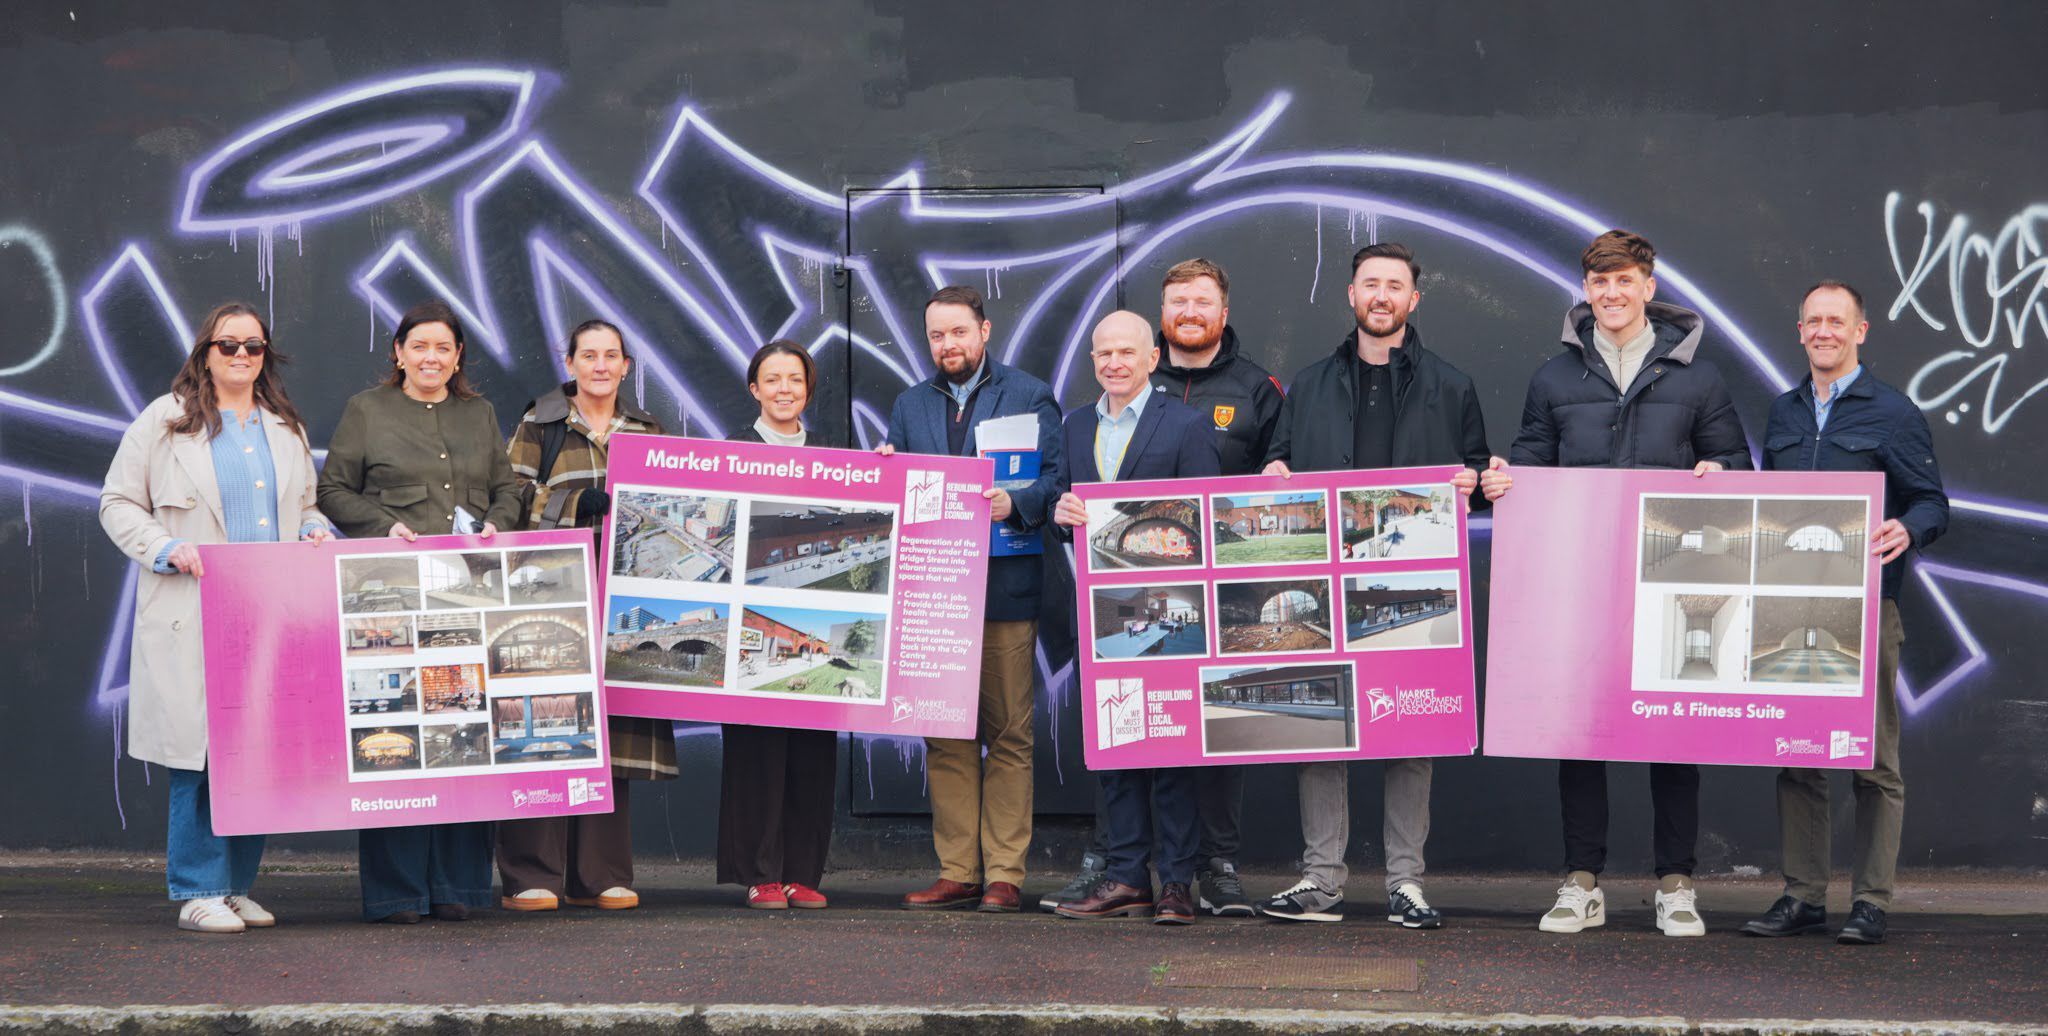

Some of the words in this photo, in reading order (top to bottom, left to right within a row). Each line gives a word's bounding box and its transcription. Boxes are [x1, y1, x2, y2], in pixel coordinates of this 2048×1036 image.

[645, 449, 720, 472] Market
[726, 455, 805, 479] Tunnels
[811, 462, 881, 486] Project
[946, 483, 982, 494] REBUILDING
[946, 492, 958, 501] THE
[945, 502, 964, 510] LOCAL
[944, 511, 974, 520] ECONOMY
[901, 536, 952, 546] Regeneration
[954, 539, 962, 547] of
[964, 539, 976, 548] the
[900, 547, 937, 556] archways
[939, 548, 962, 556] under
[900, 555, 925, 564] Bridge
[927, 555, 949, 564] Street
[951, 557, 966, 566] into
[899, 563, 926, 572] vibrant
[928, 566, 970, 577] community
[899, 573, 924, 582] spaces
[926, 573, 941, 581] that
[943, 575, 957, 583] will
[904, 591, 930, 599] Create
[932, 592, 947, 600] 60+
[951, 592, 967, 602] jobs
[904, 600, 932, 609] Provide
[934, 601, 971, 612] childcare,
[903, 609, 927, 617] health
[930, 610, 944, 618] and
[947, 611, 969, 620] social
[902, 618, 928, 626] spaces
[902, 626, 940, 635] Reconnect
[942, 628, 955, 636] the
[901, 635, 929, 643] Market
[930, 637, 973, 647] community
[901, 643, 919, 651] back
[921, 644, 936, 652] into
[938, 645, 950, 653] the
[953, 646, 967, 655] City
[900, 651, 926, 660] Centre
[900, 661, 918, 669] Over
[921, 662, 938, 670] £2.6
[940, 663, 966, 671] million
[899, 669, 940, 679] investment
[1147, 690, 1193, 701] REBUILDING
[1400, 688, 1435, 699] MARKET
[917, 700, 946, 708] MARKET
[1400, 695, 1462, 707] DEVELOPMENT
[1148, 702, 1163, 713] THE
[1400, 705, 1462, 715] ASSOCIATION
[1631, 700, 1668, 718] Gym
[1672, 701, 1684, 716] &
[1689, 702, 1742, 718] Fitness
[1746, 703, 1785, 719] Suite
[1148, 714, 1173, 725] LOCAL
[1116, 727, 1141, 735] DISSENT
[1149, 726, 1186, 738] ECONOMY
[351, 794, 438, 812] Restaurant
